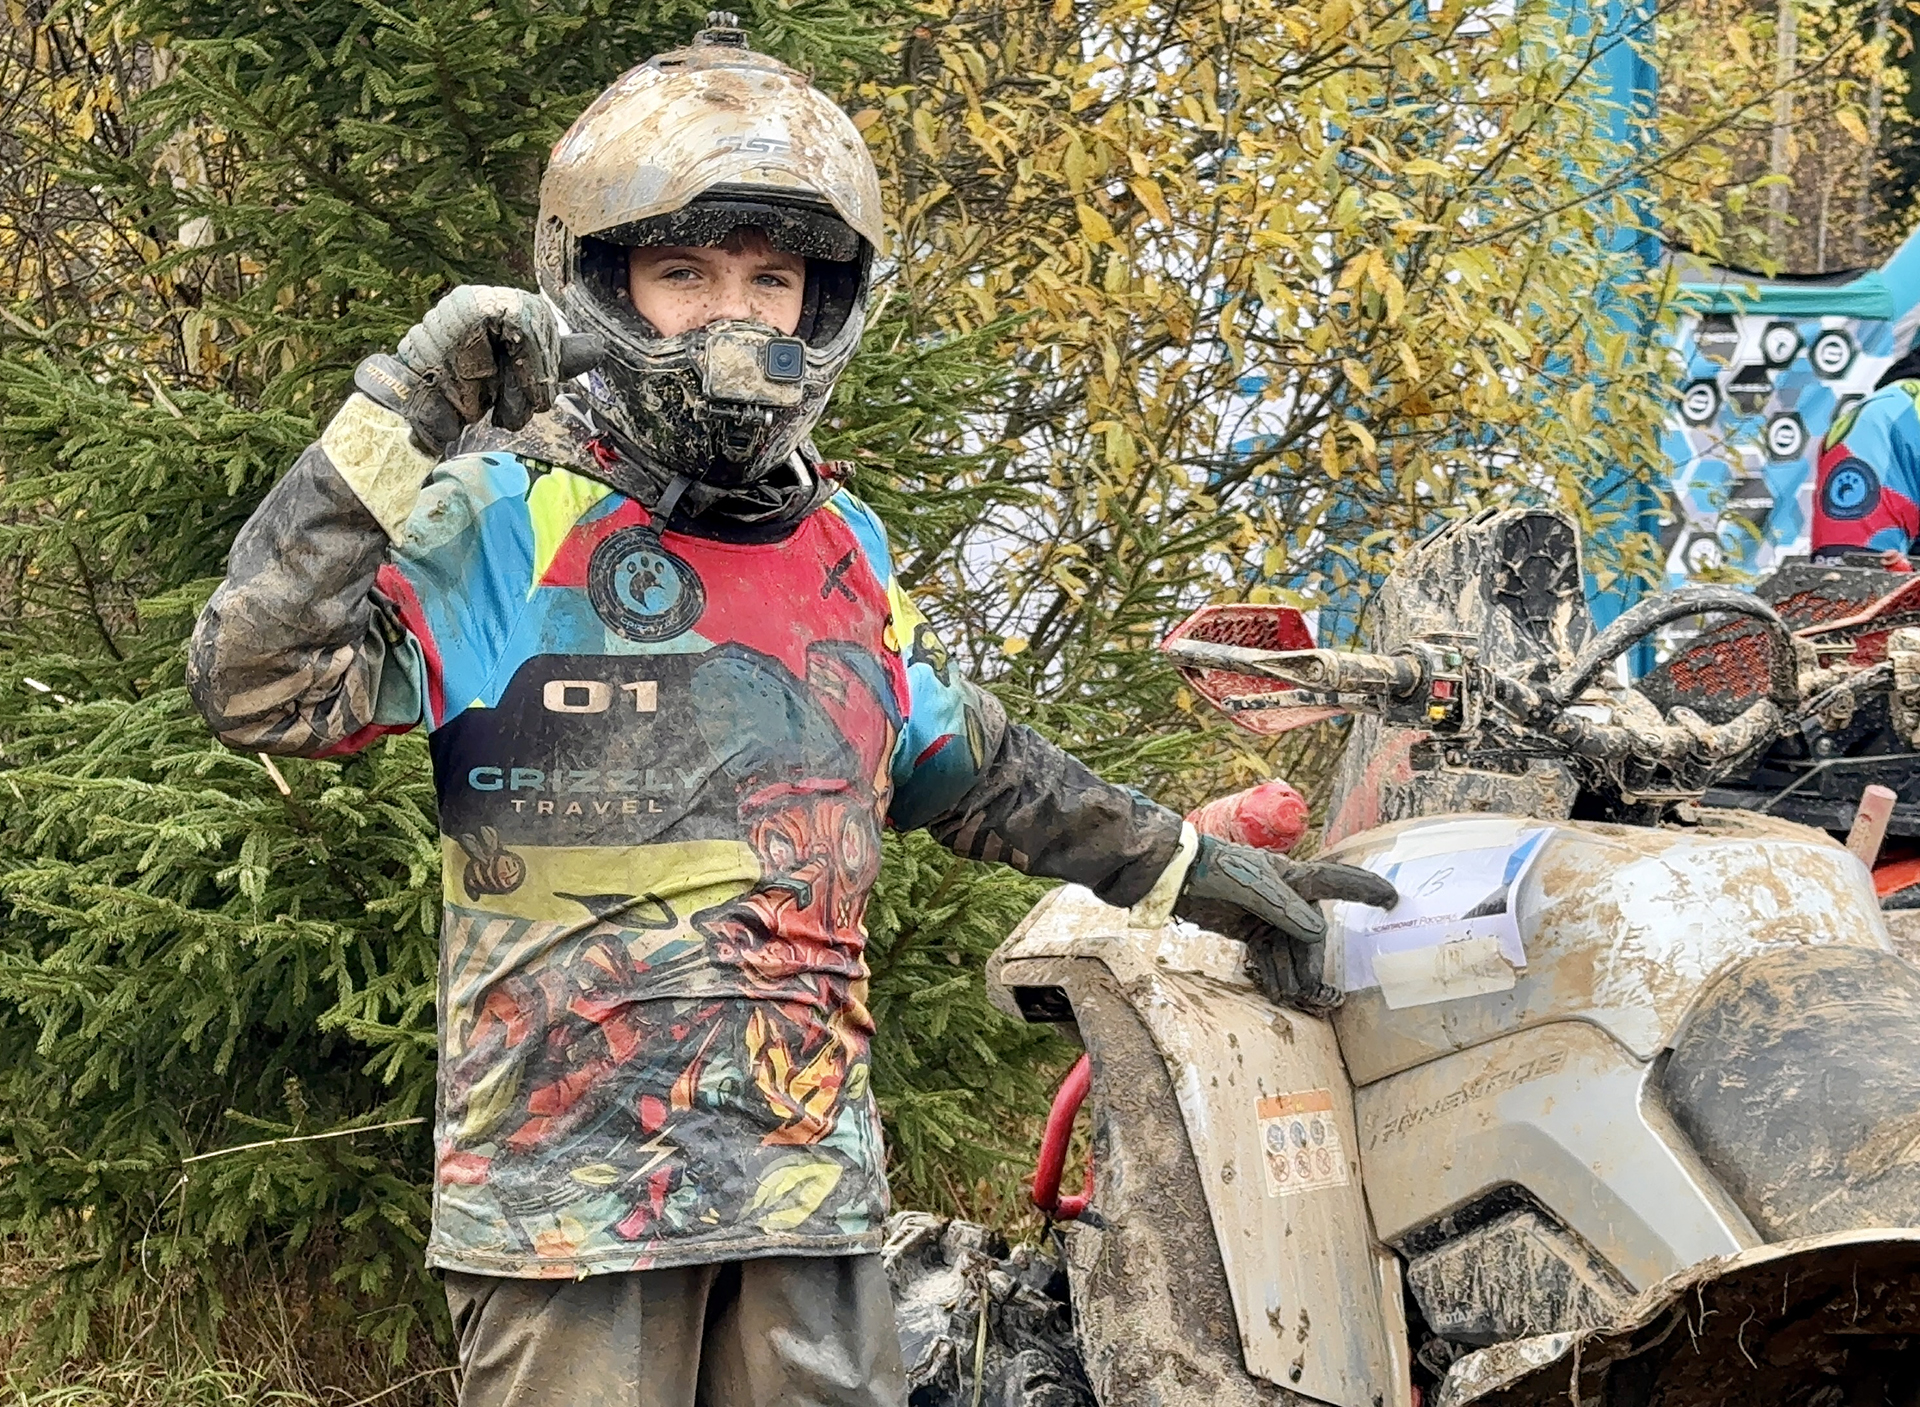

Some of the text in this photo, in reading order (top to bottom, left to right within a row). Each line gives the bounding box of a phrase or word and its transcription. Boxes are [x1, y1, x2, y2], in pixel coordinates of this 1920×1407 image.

[365, 362, 411, 400] makita
[543, 680, 658, 714] 01
[468, 765, 708, 793] GRIZZLY
[511, 799, 663, 815] TRAVEL
[1435, 1307, 1475, 1327] ROTAX
